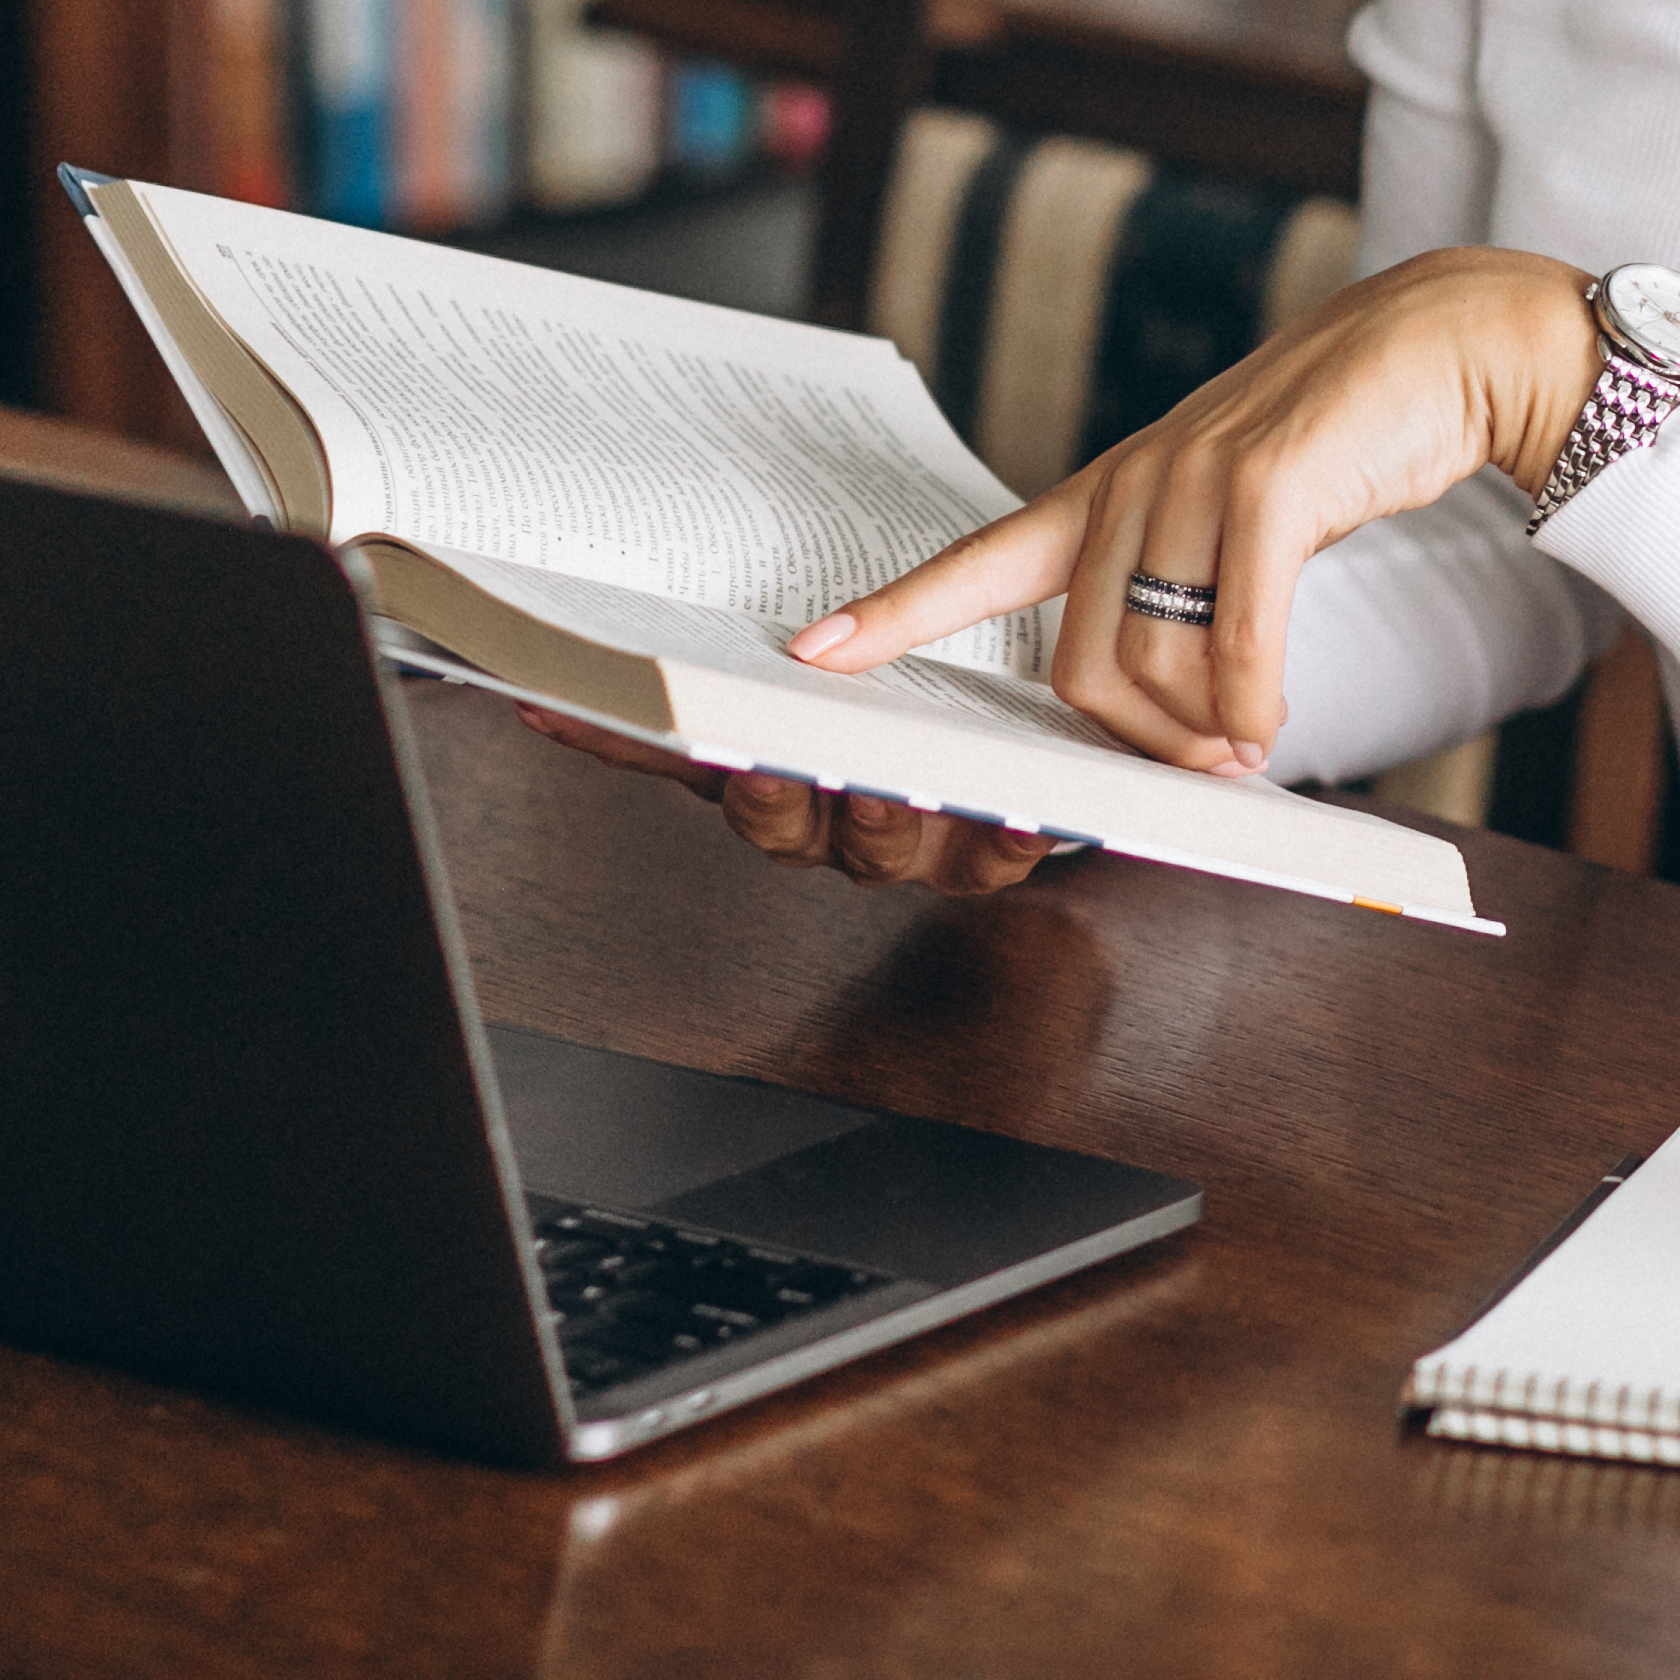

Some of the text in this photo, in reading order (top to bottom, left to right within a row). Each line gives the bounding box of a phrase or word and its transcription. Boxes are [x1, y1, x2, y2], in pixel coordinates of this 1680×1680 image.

[416, 452, 436, 509] инвестор
[443, 448, 468, 512] доходности
[464, 463, 479, 484] Тип
[478, 459, 498, 508] стоящих
[492, 438, 529, 510] соотношению
[513, 449, 544, 507] следующие
[533, 457, 564, 531] агрессивного
[605, 465, 640, 527] стабильный
[380, 460, 394, 534] Управление
[409, 486, 421, 538] (акций,
[434, 465, 454, 546] ределенный
[537, 510, 547, 526] на
[553, 468, 579, 534] извлечение
[569, 470, 595, 537] умеренного
[586, 455, 627, 544] консервативного
[665, 493, 688, 544] добиться
[460, 521, 469, 548] нем
[491, 514, 501, 553] задач,
[520, 514, 532, 535] По
[597, 504, 613, 541] риска
[633, 530, 643, 547] но
[643, 510, 659, 563] Главное
[682, 498, 706, 566] следующие
[507, 533, 517, 559] вых
[539, 531, 548, 566] ются
[758, 559, 767, 569] и
[666, 547, 675, 593] жении
[678, 551, 690, 595] Чтобы
[696, 569, 706, 601] дать
[722, 530, 739, 608] определяет
[787, 583, 799, 594] 2.
[804, 564, 814, 588] что
[743, 595, 752, 611] ее
[758, 579, 768, 614] ного
[804, 594, 815, 624] сам,
[834, 593, 844, 603] 3.
